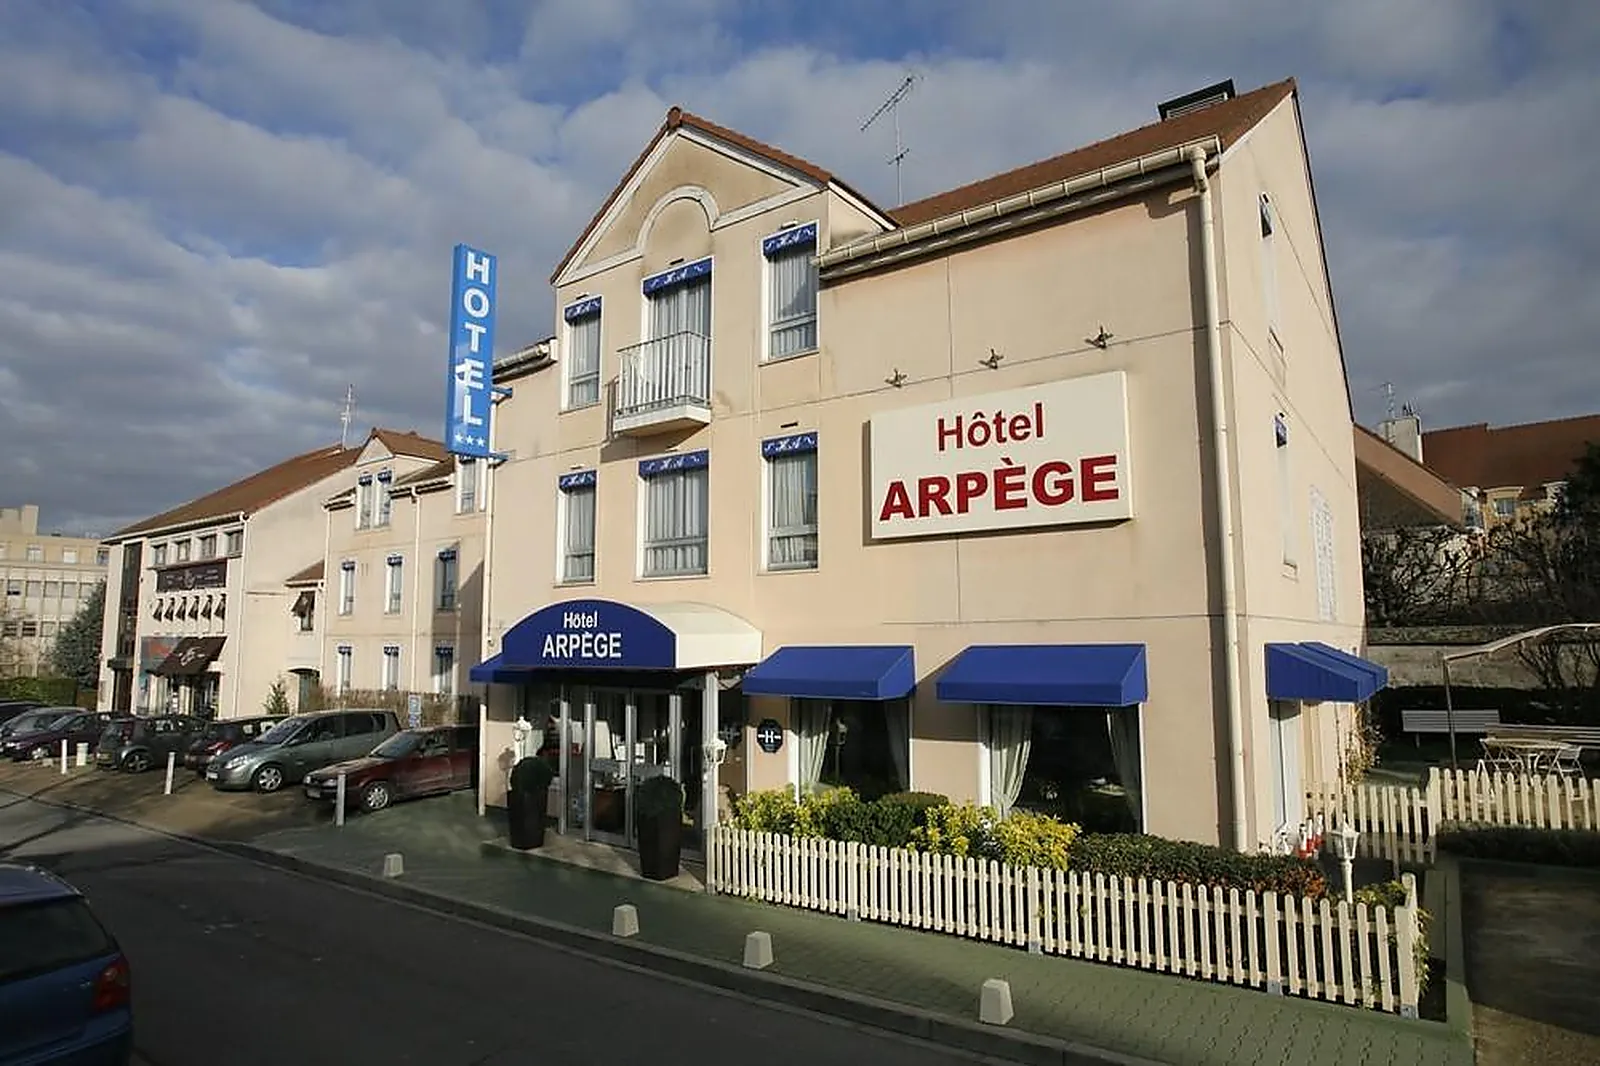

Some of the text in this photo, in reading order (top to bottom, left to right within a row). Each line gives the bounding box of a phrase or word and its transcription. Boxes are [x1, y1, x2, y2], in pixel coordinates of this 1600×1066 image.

[463, 251, 490, 426] HOTEL
[937, 402, 1044, 451] Hôtel
[879, 455, 1119, 521] ARPÈGE
[563, 610, 598, 629] Hôtel
[542, 631, 622, 658] ARPÈGE
